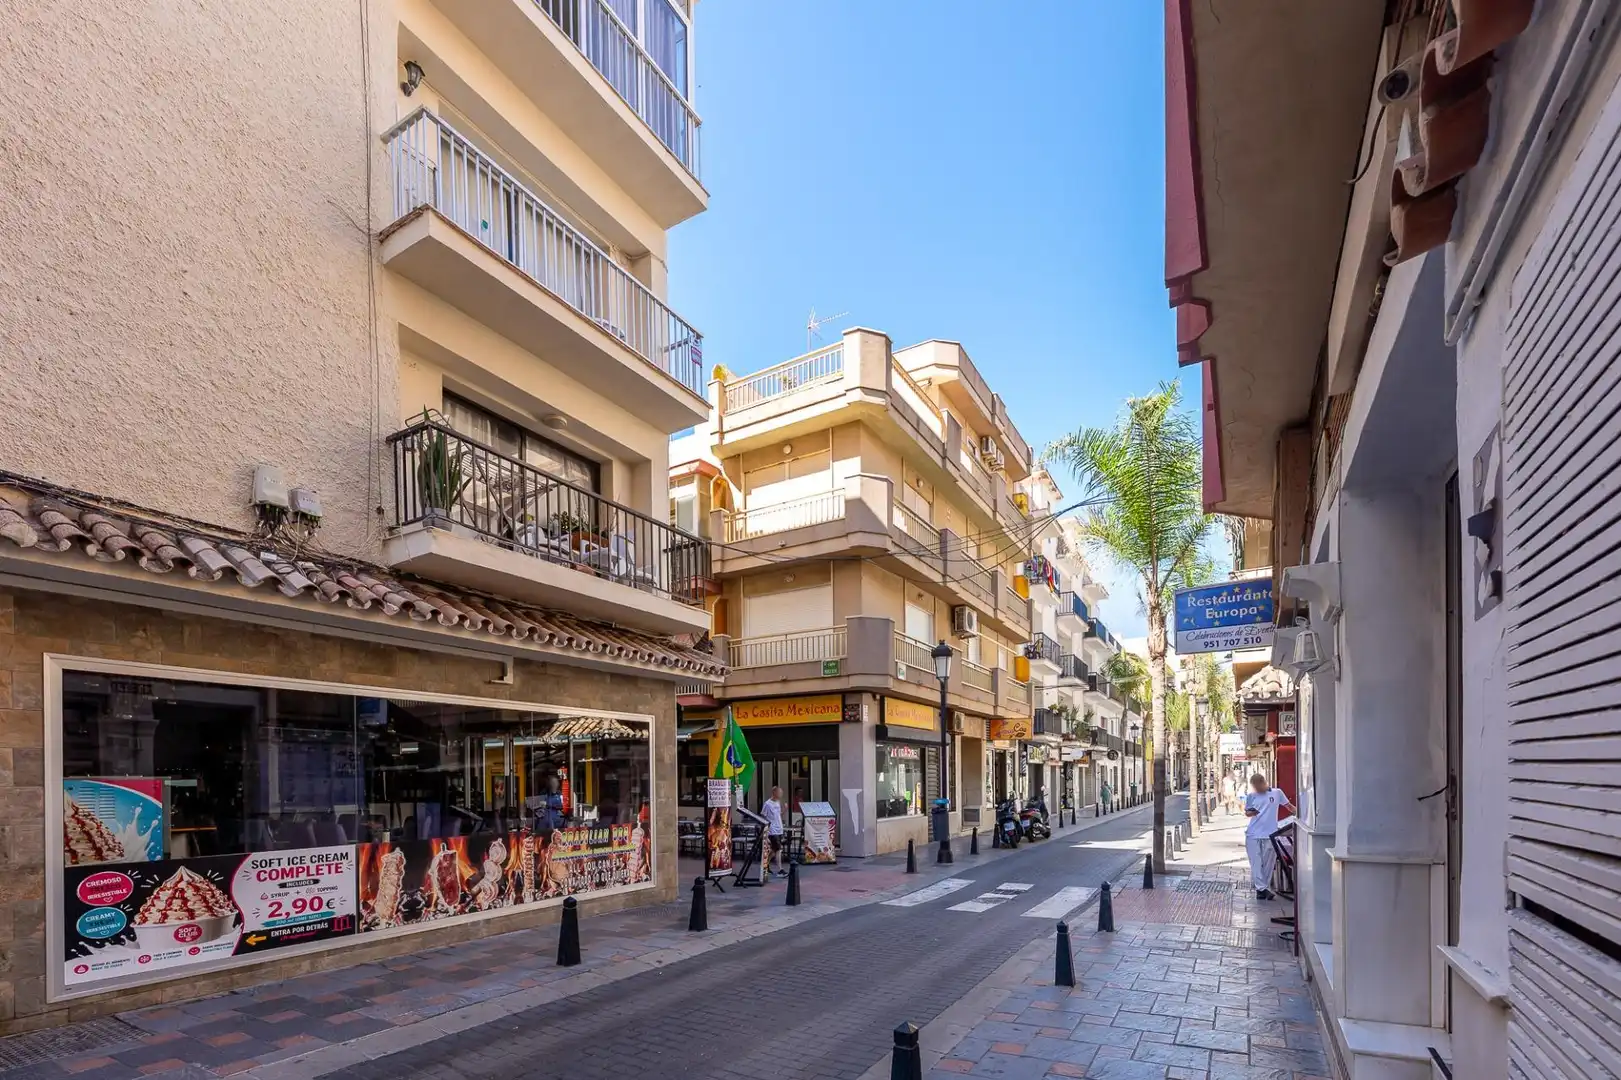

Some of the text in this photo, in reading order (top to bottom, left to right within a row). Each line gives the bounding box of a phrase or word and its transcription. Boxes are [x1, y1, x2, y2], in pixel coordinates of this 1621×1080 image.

[1206, 605, 1257, 618] Europa
[1234, 626, 1243, 636] de
[1203, 636, 1262, 648] 951 707 510
[736, 703, 840, 719] La Casita Mexicana
[251, 851, 349, 870] SOFT ICE CREAM
[256, 863, 344, 882] COMPLETE
[86, 877, 122, 888] CREMOSO
[286, 880, 314, 888] INCLUDES
[87, 888, 128, 900] IRRESISTIBLE
[85, 912, 116, 922] CREAMY
[271, 929, 291, 937] ENTRA
[306, 922, 328, 932] DETRÁS
